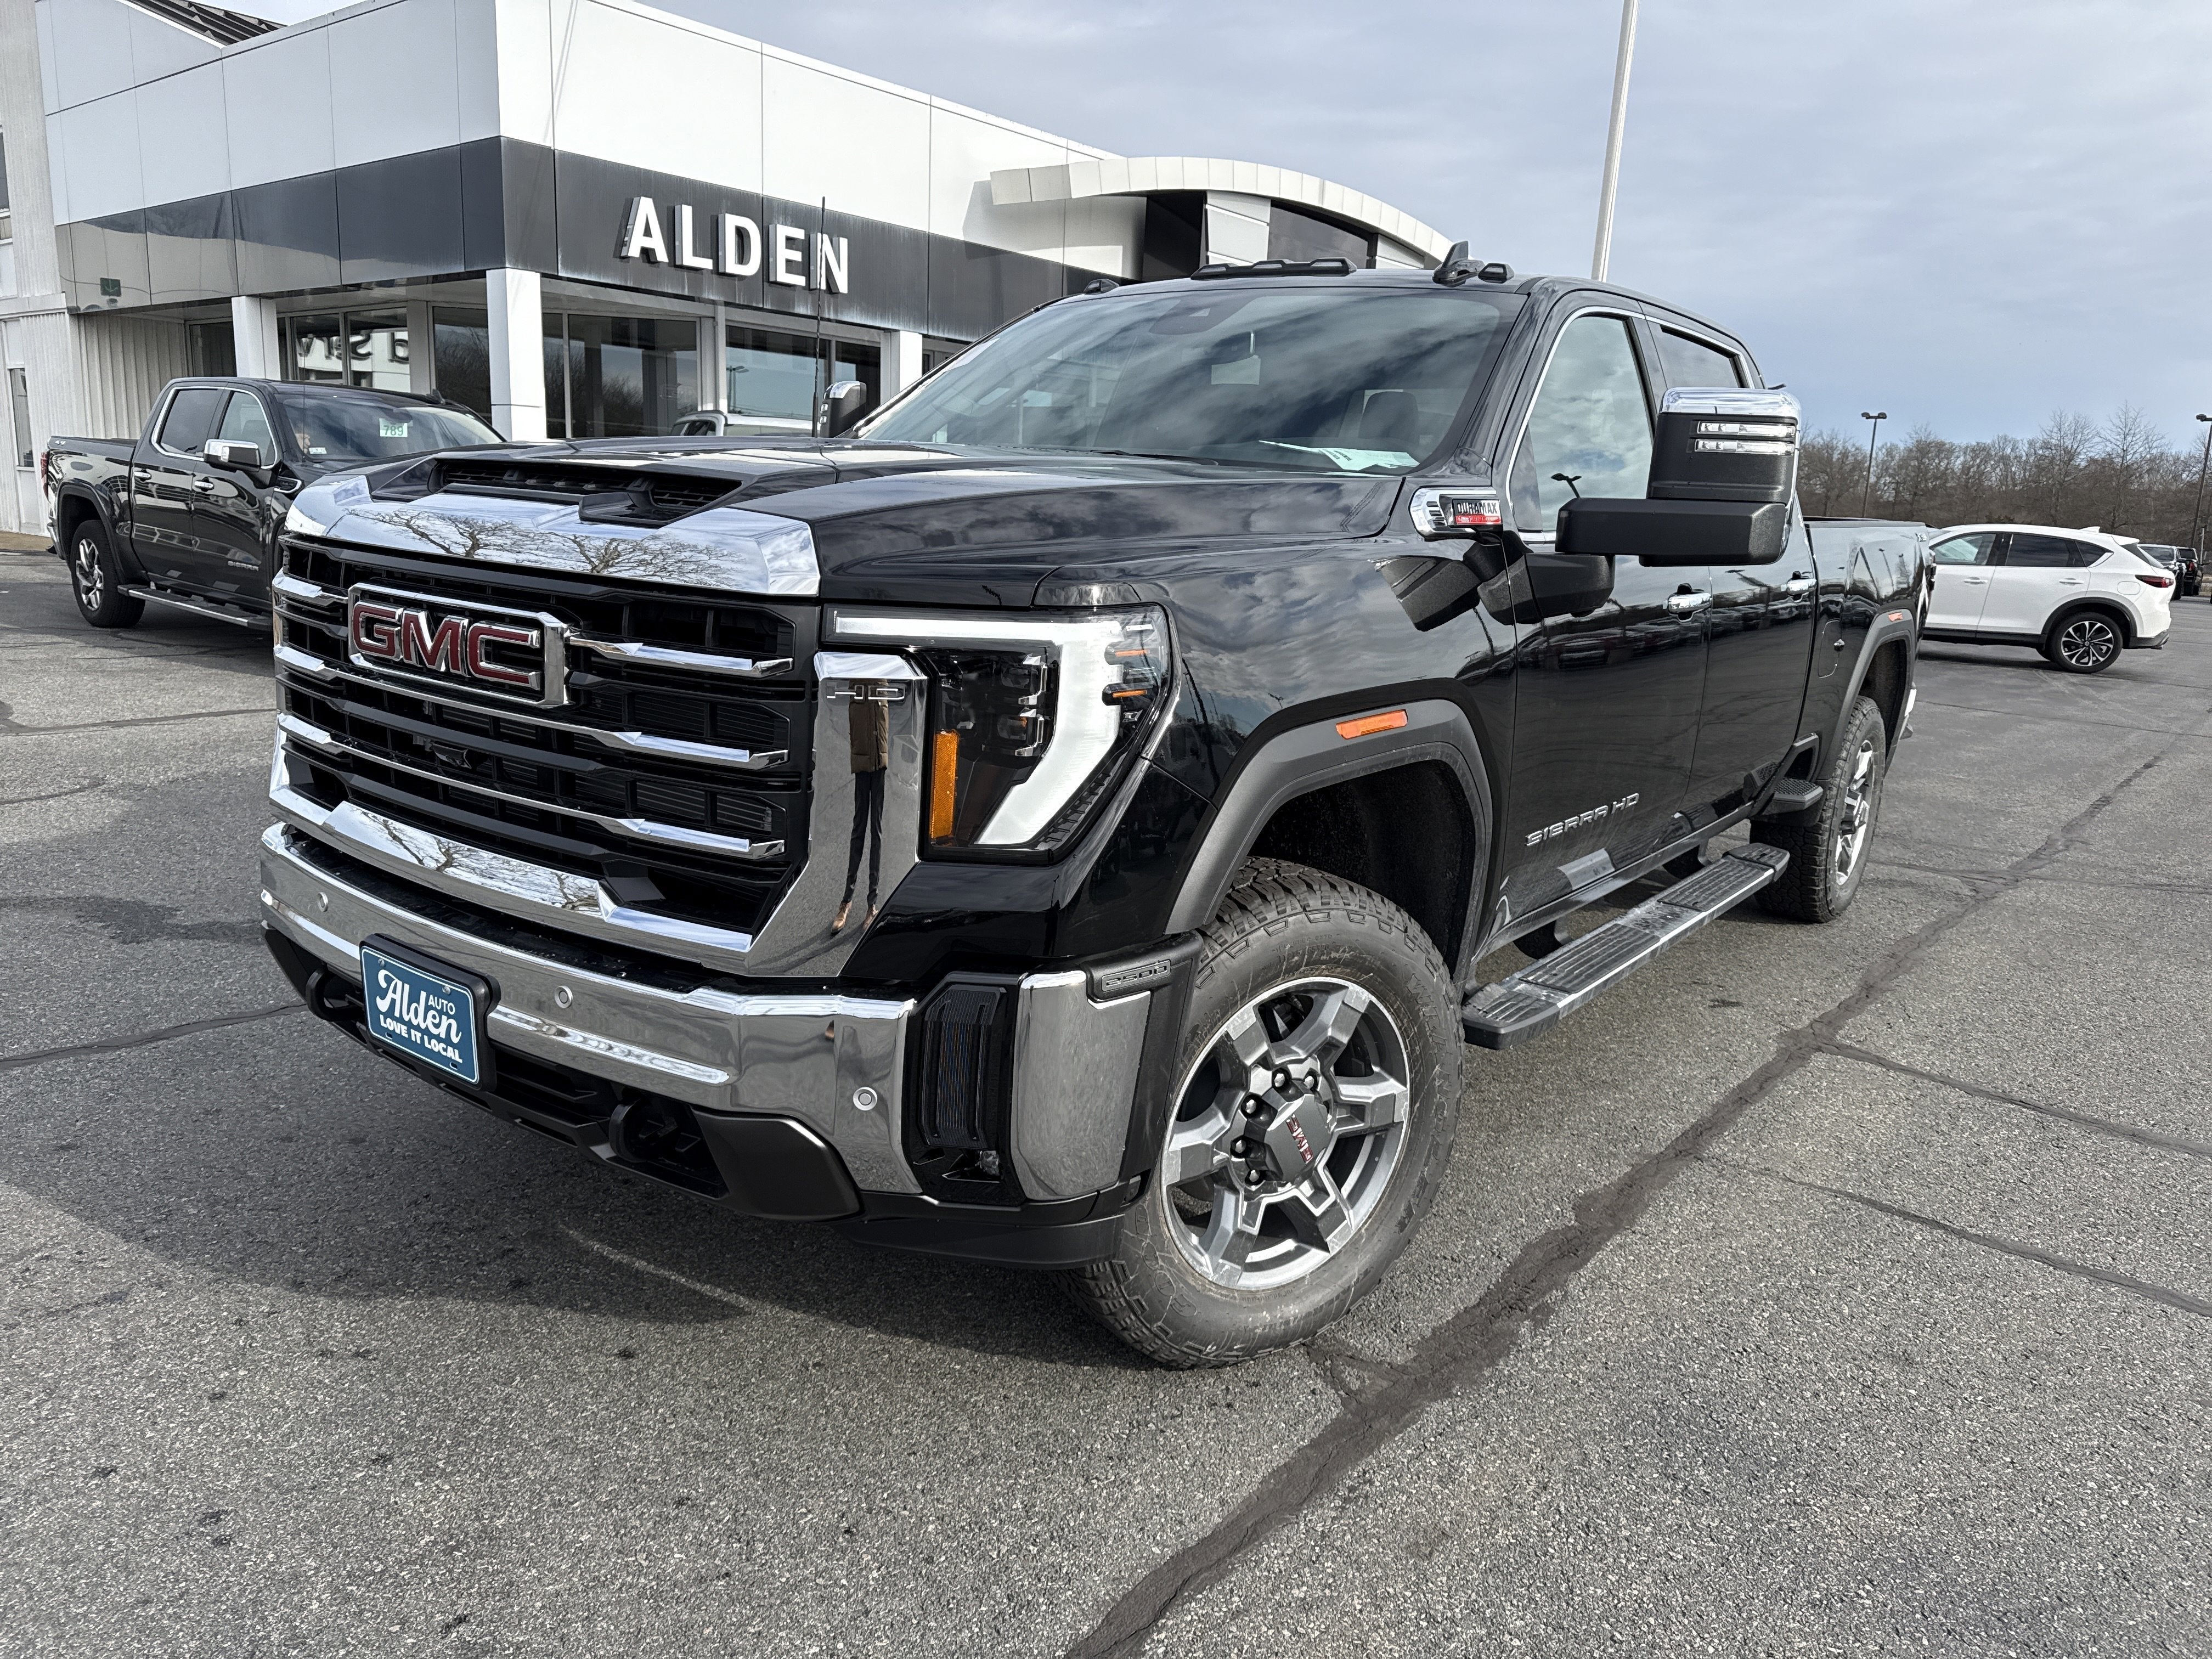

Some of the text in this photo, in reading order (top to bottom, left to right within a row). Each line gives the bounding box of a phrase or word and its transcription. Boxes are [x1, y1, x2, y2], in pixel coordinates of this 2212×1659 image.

[622, 196, 848, 294] ALDEN
[383, 425, 403, 436] 789
[1456, 501, 1498, 514] DURAMAX
[353, 600, 540, 690] GMC
[1526, 793, 1639, 846] SIERRA HD
[1105, 966, 1168, 988] 2500
[376, 969, 462, 1043] Alden
[428, 994, 456, 1015] AUTO
[379, 1014, 462, 1063] LOVE IT LOCAL
